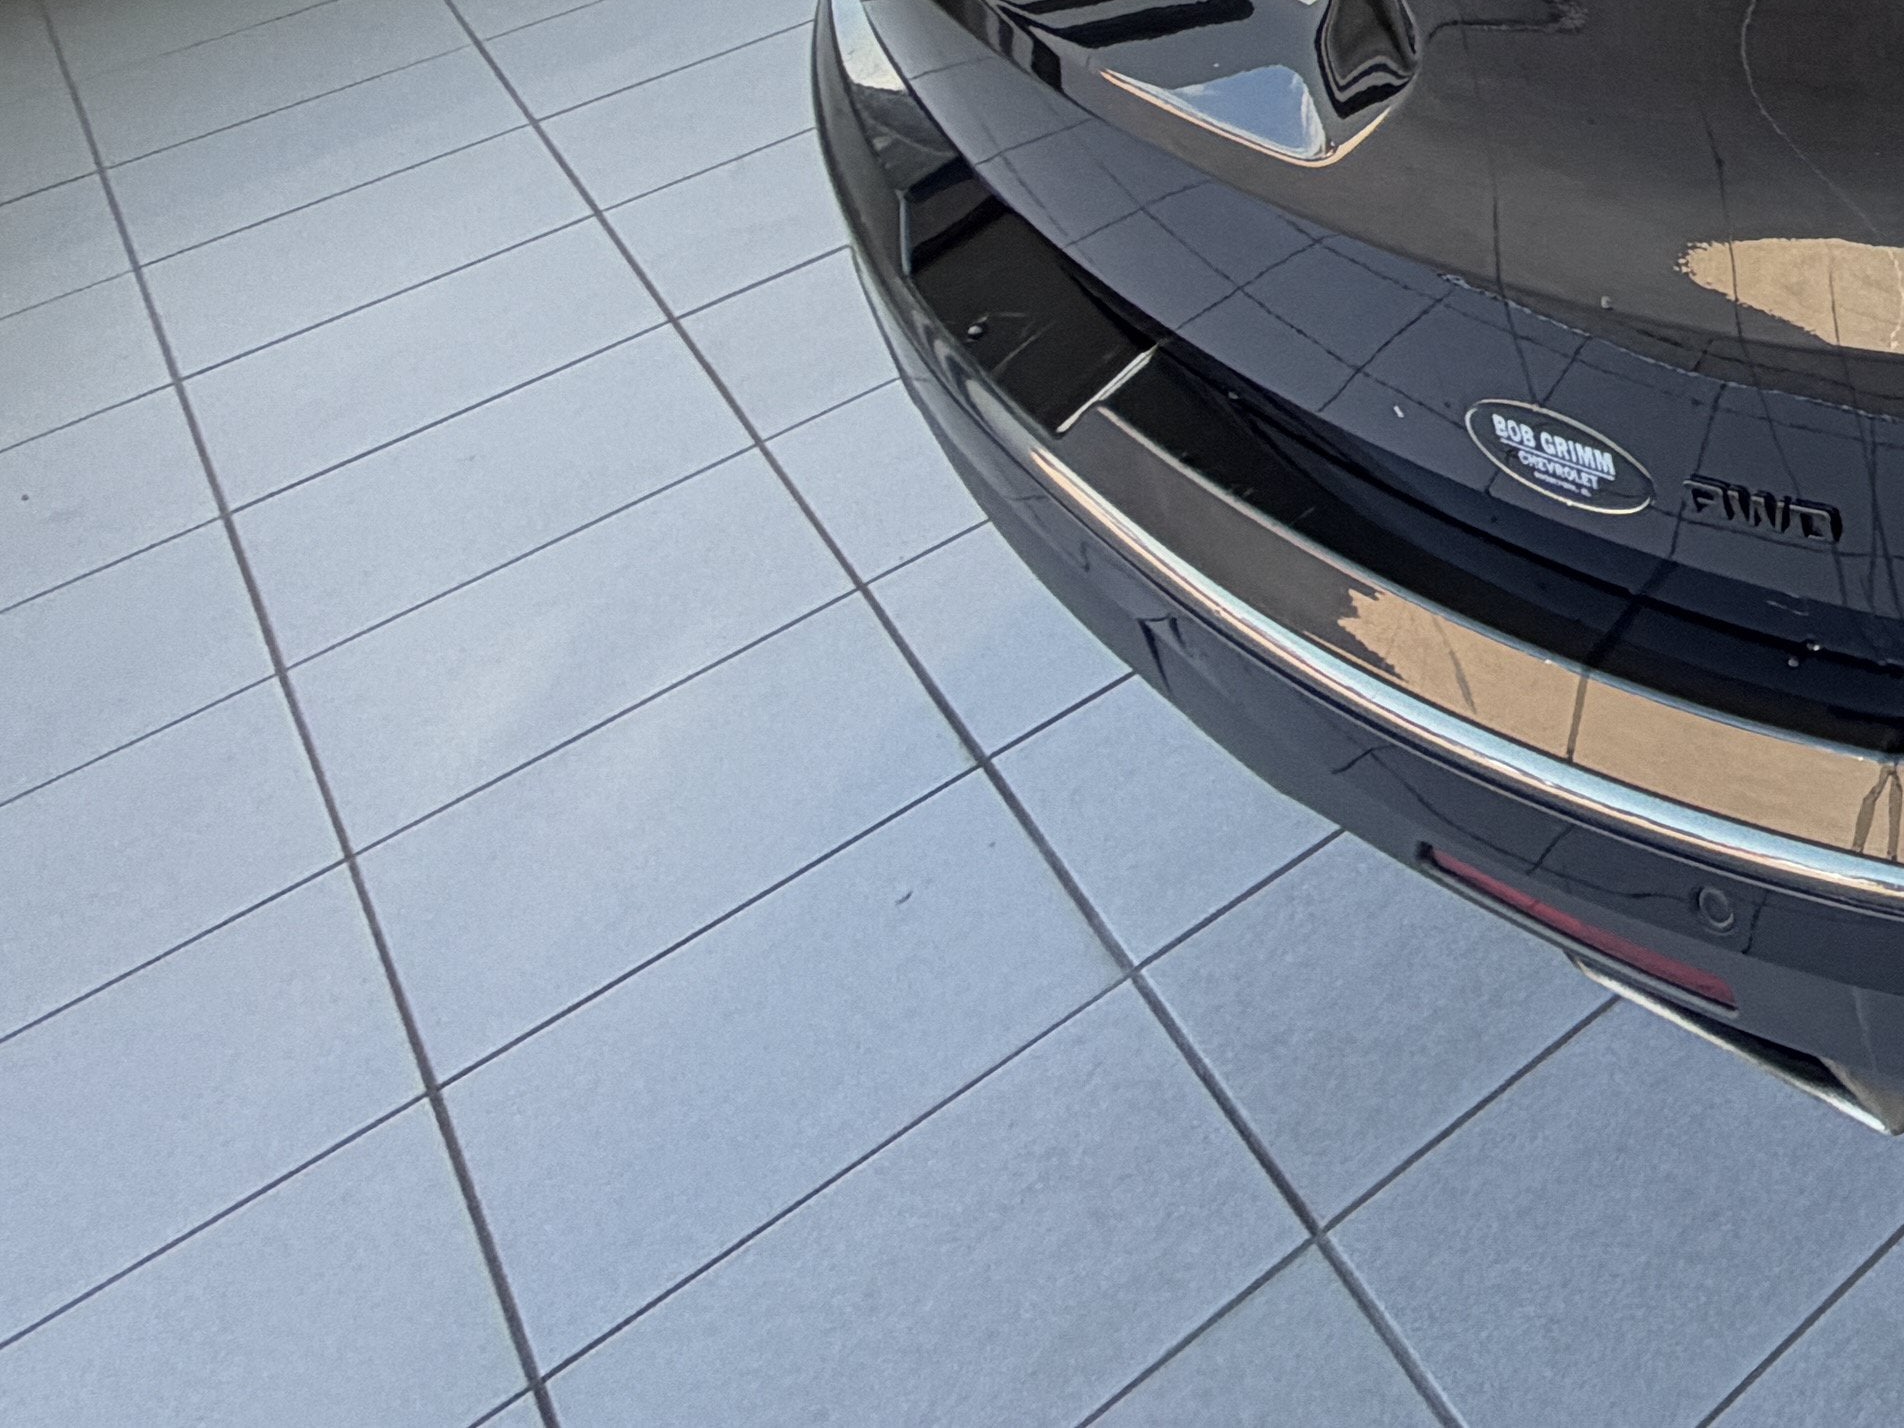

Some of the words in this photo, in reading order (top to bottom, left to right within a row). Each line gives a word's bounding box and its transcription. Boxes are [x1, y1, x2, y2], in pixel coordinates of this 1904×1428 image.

[1491, 412, 1536, 446] BOB
[1540, 430, 1617, 477] GRIMM
[1517, 448, 1599, 491] CHEVROLET
[1681, 472, 1845, 544] AWD
